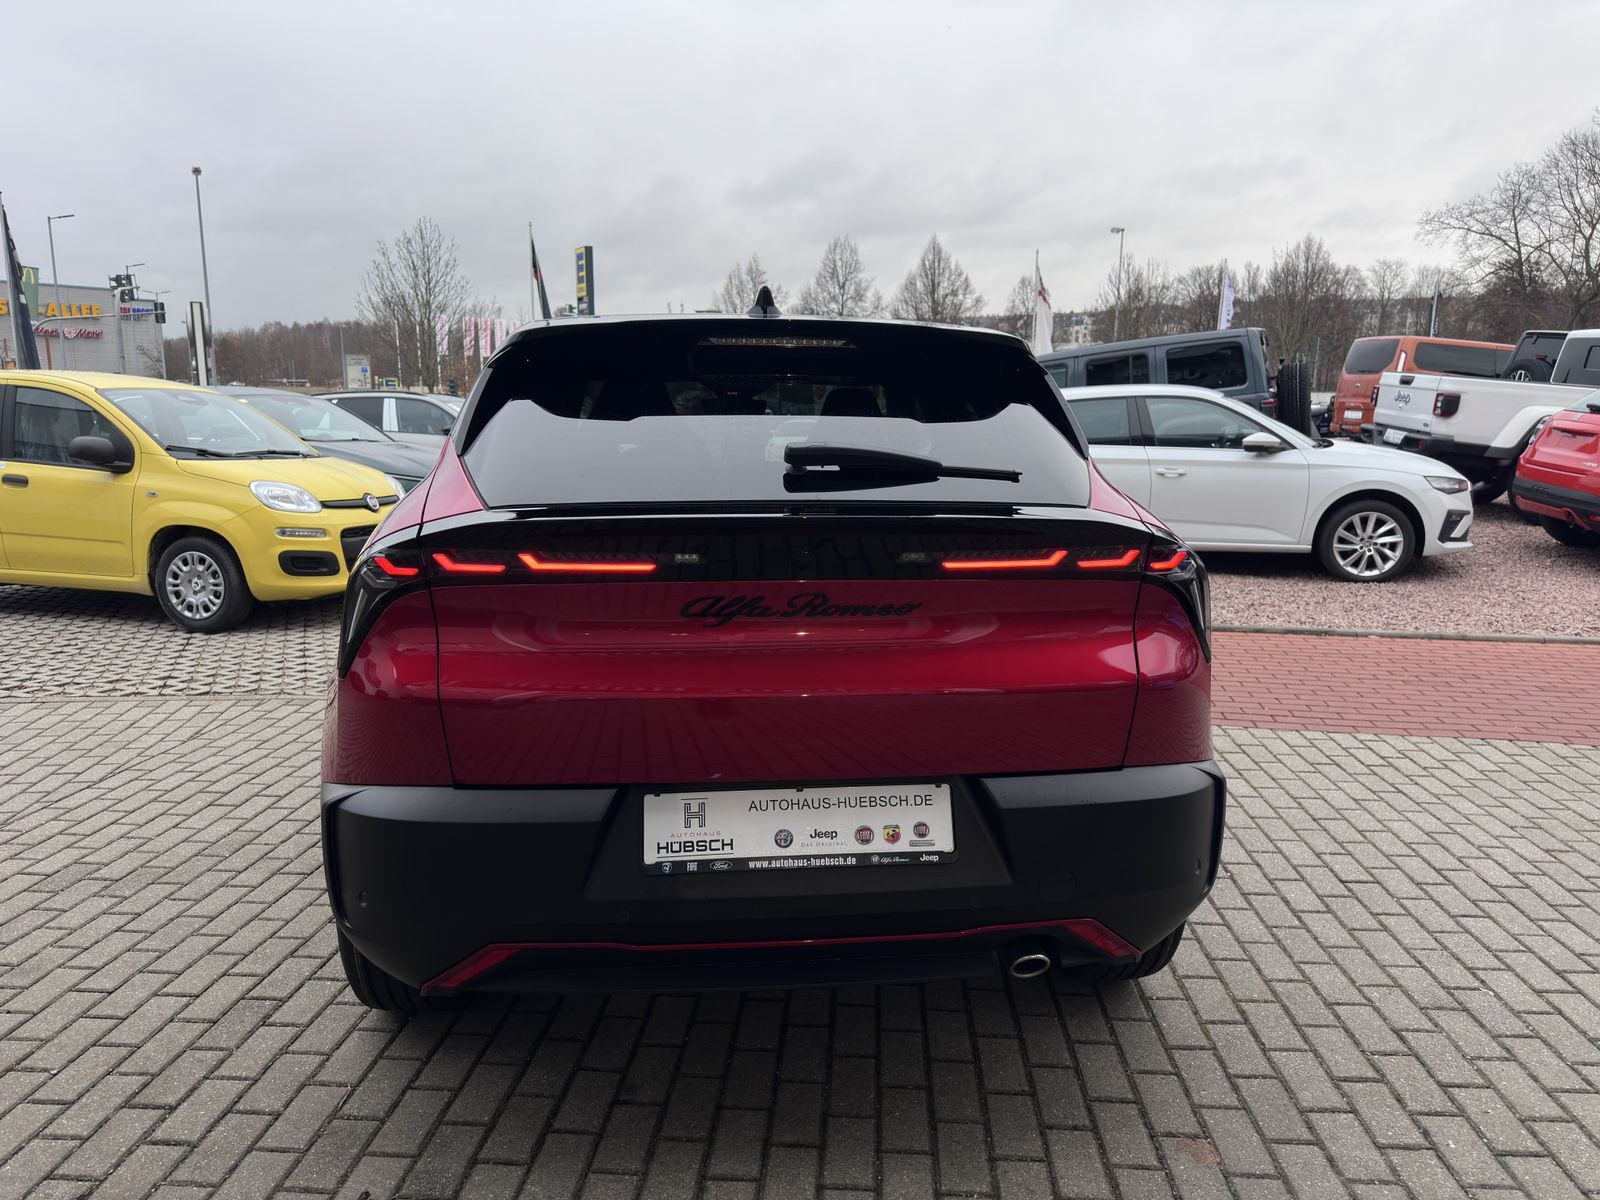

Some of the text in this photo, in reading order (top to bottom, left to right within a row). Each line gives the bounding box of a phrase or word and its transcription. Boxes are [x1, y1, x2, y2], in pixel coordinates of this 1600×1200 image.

[1394, 391, 1411, 405] Jeep
[680, 592, 923, 628] Alfa Romeo
[748, 794, 934, 812] AUTOHAUS-HUEBSCH.DE
[809, 828, 838, 840] Jeep
[656, 838, 734, 855] HÜBSCH
[748, 856, 857, 869] www.autohaus-huebsch.de
[920, 853, 939, 863] Jeep
